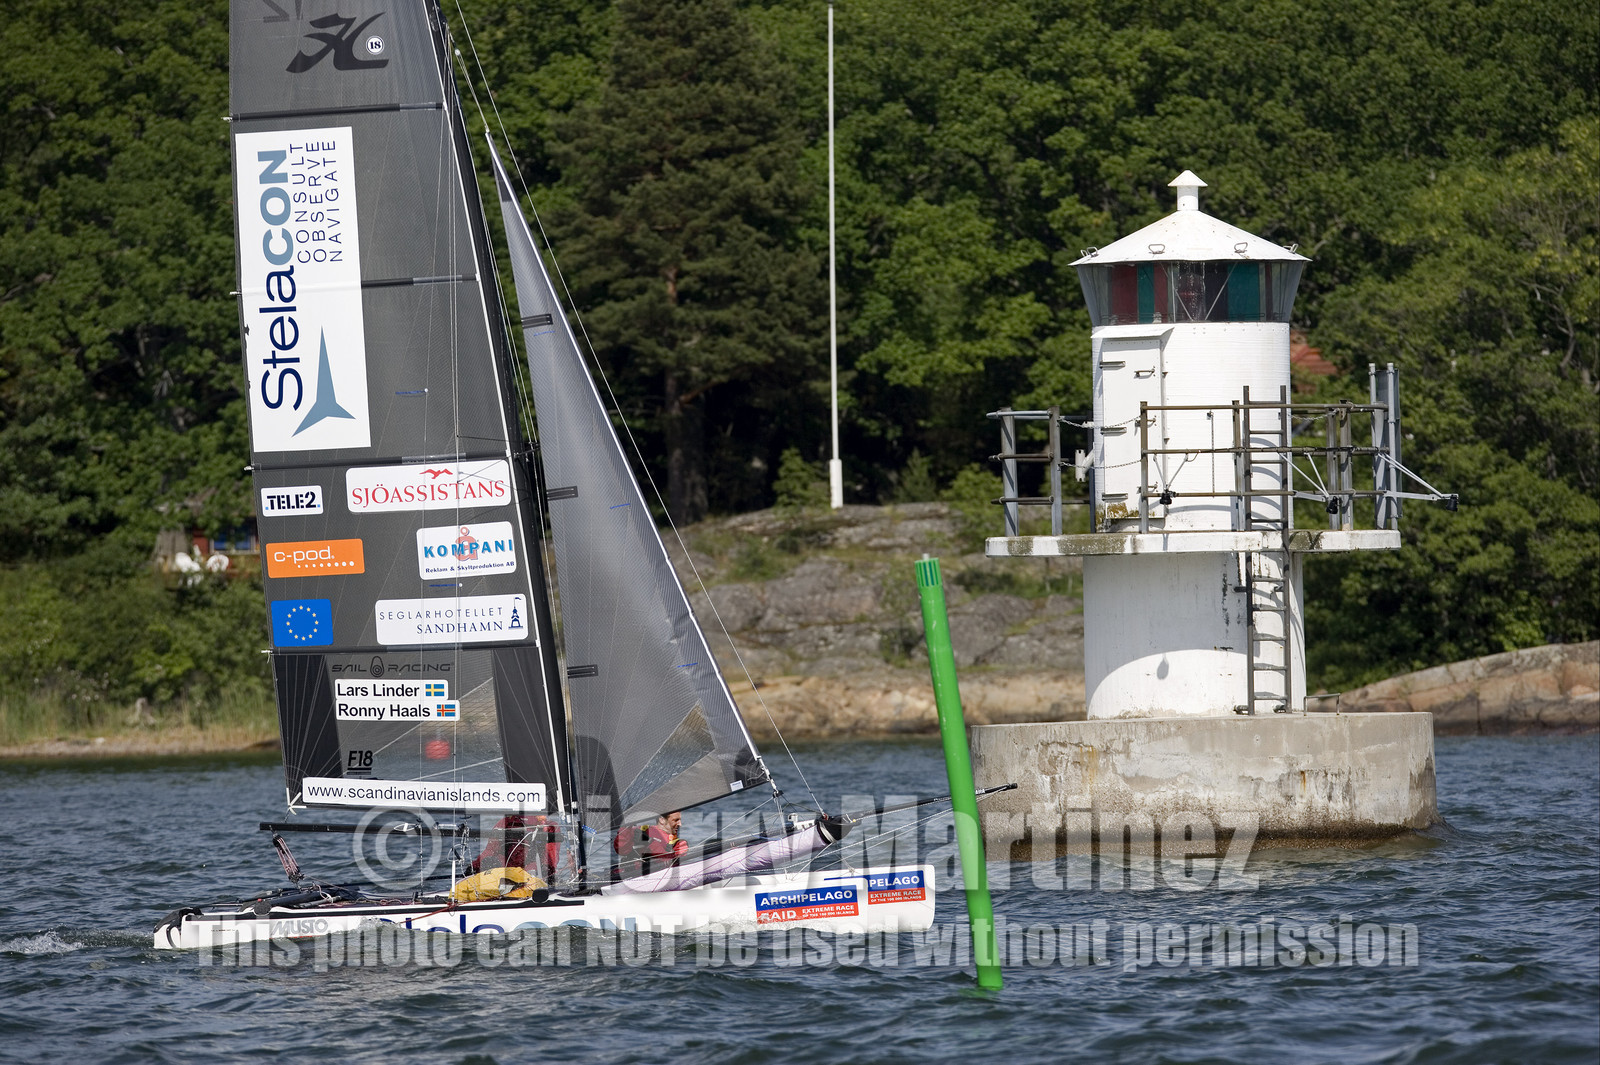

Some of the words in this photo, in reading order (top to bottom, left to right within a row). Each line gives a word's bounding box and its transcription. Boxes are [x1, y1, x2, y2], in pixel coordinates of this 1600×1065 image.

[369, 40, 382, 50] 18
[289, 143, 311, 263] CONSULT
[305, 141, 327, 263] OBSERVE
[321, 140, 343, 262] NAVIGATE
[352, 480, 505, 508] SJÖASSISTANS
[423, 539, 514, 558] KOMPANI
[457, 562, 504, 571] Skyltproduktion
[379, 606, 503, 621] SEGLARHOTELLET
[416, 620, 503, 635] SANDHAMN
[331, 664, 367, 673] SAIL
[387, 663, 451, 672] RACING
[337, 683, 369, 697] Lars
[373, 683, 420, 697] Linder
[338, 703, 386, 721] Ronny
[389, 704, 431, 717] Haals
[348, 750, 373, 766] F18
[307, 783, 541, 803] www.scandinavianislands.com
[760, 889, 853, 907] ARCHIPELAGO
[870, 891, 902, 899] EXTREME
[802, 906, 834, 914] EXTREME
[271, 918, 329, 936] MUSTO
